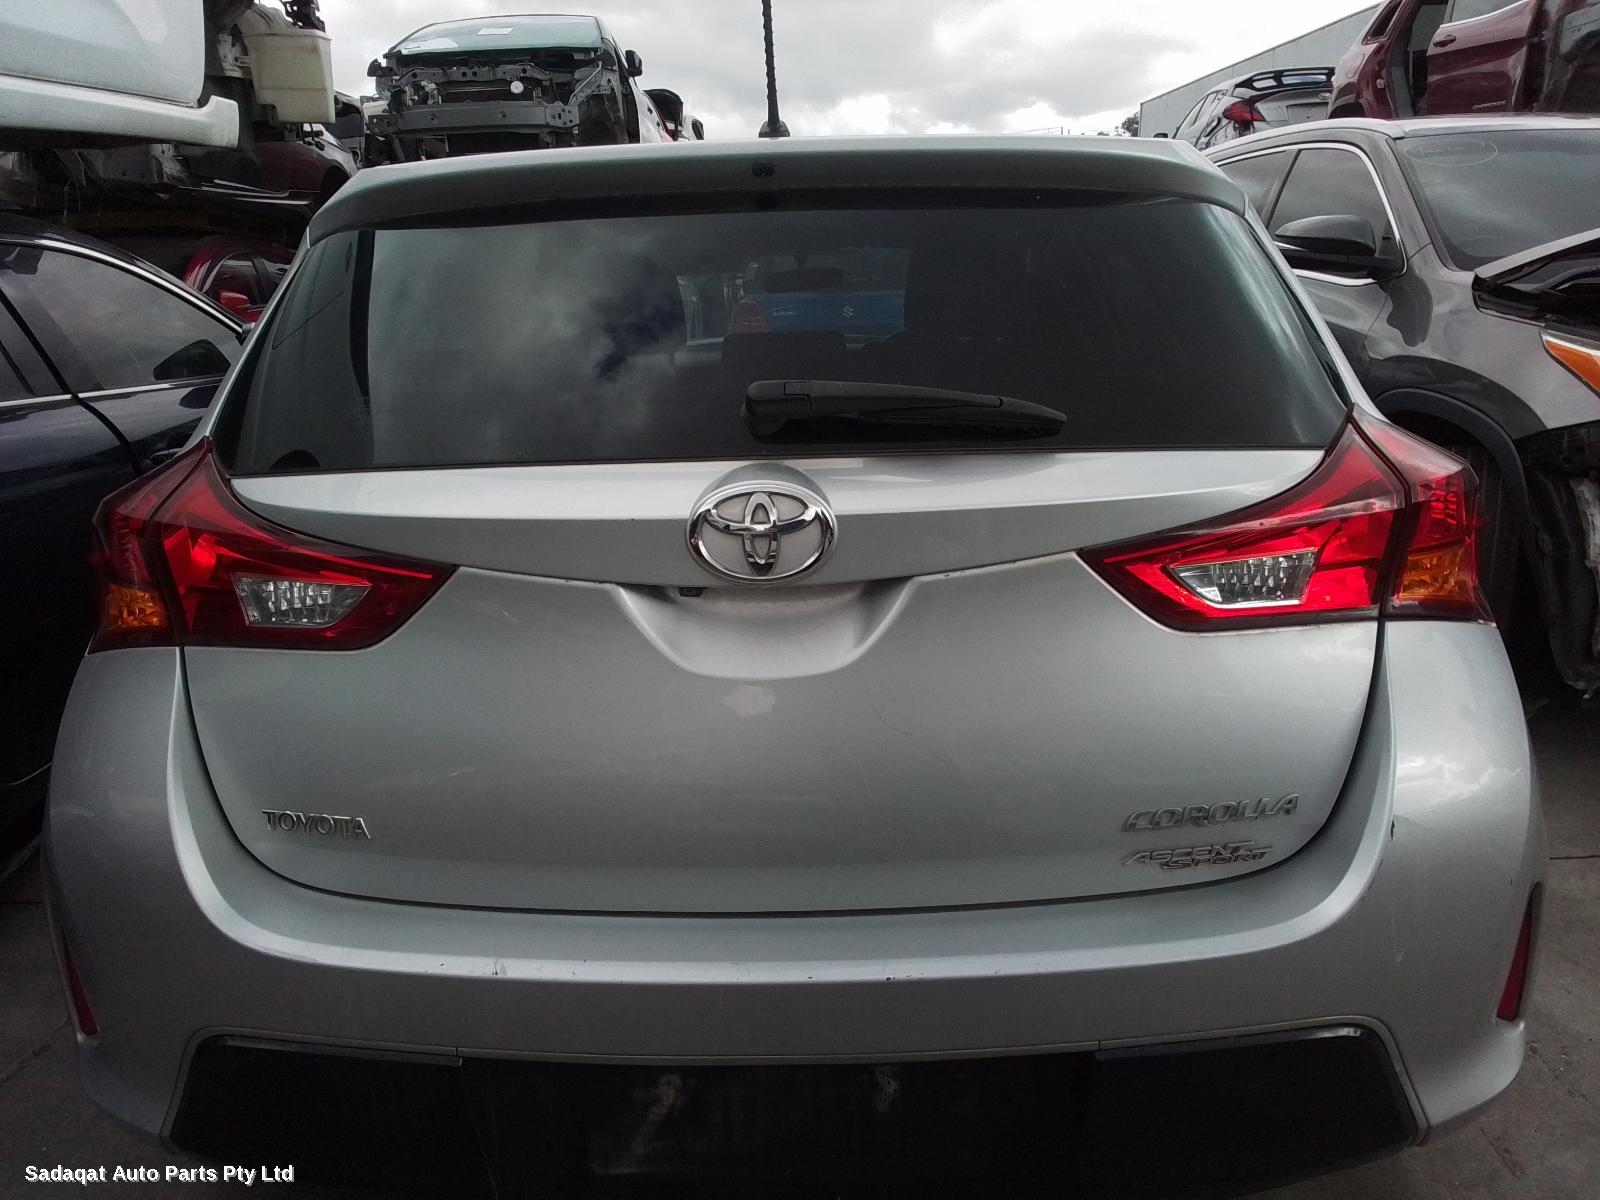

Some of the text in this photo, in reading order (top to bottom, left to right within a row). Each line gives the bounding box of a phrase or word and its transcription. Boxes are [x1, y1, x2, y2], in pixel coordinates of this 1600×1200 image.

[260, 808, 371, 840] TOYOTA
[1124, 793, 1300, 830] COROLLA
[1122, 839, 1256, 865] ASCENT
[1161, 846, 1272, 870] SPORT
